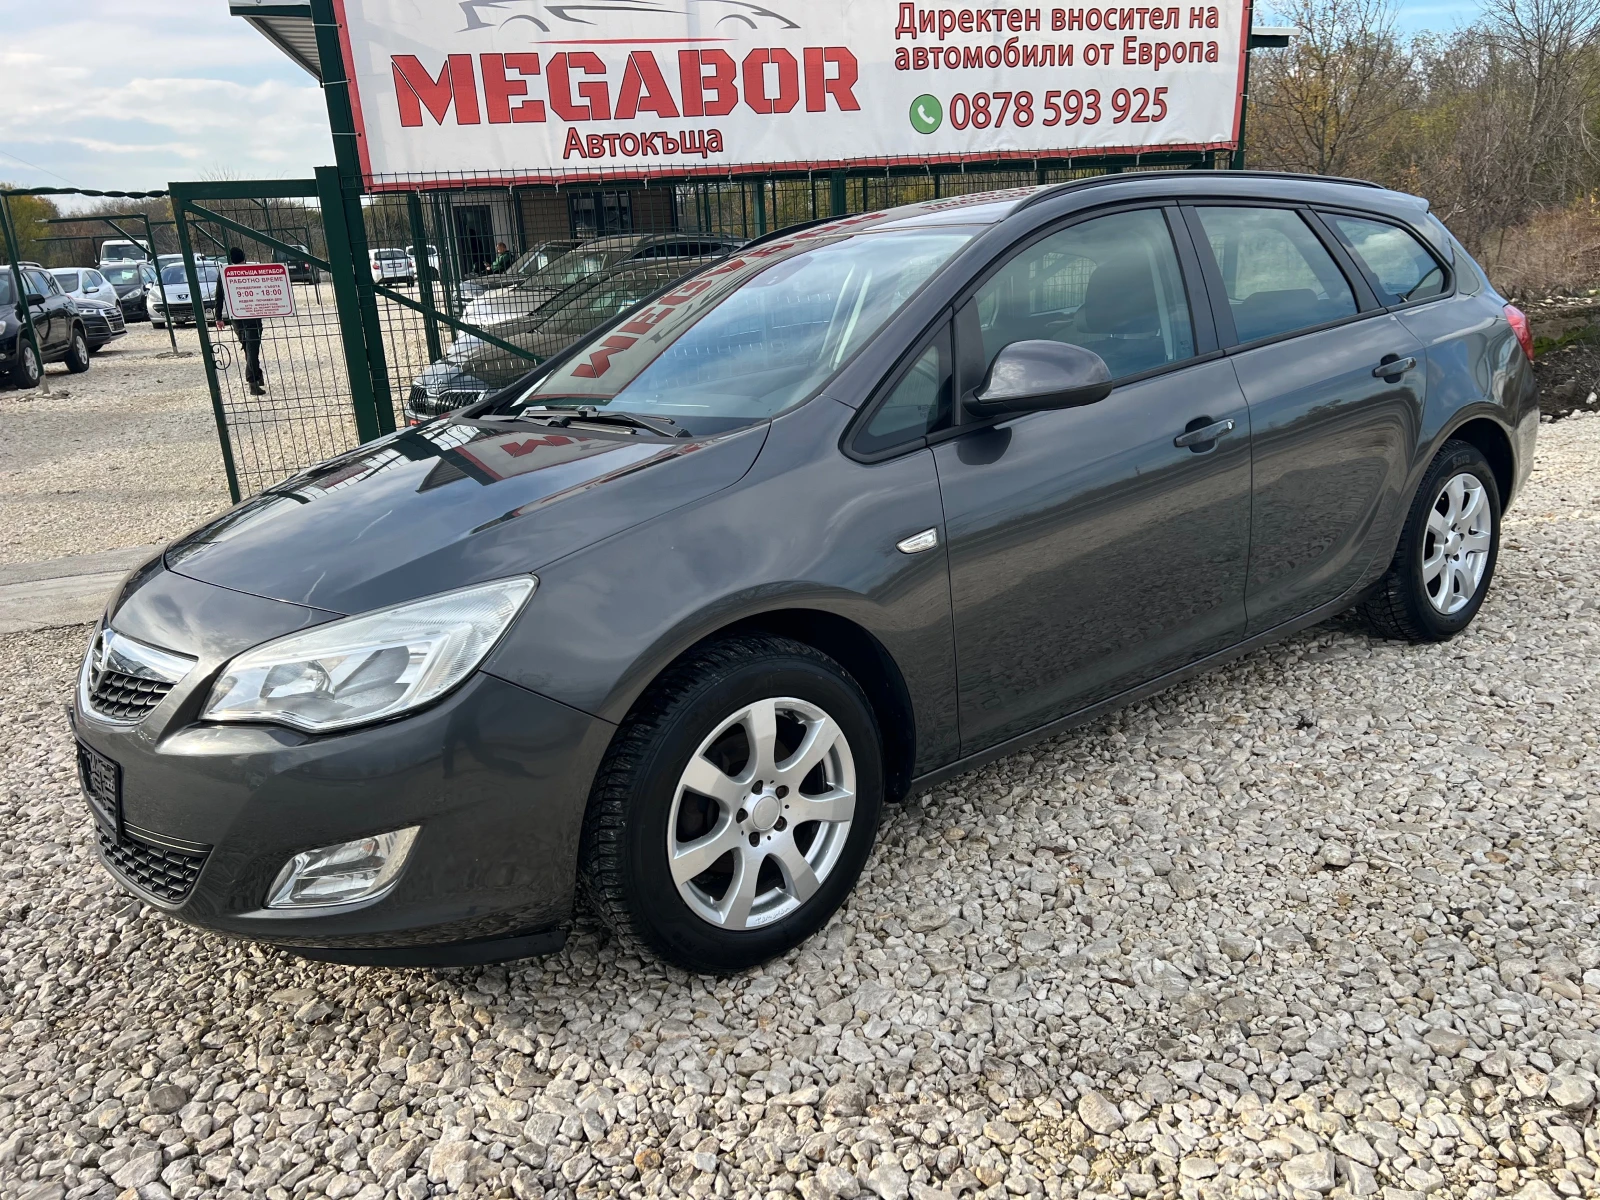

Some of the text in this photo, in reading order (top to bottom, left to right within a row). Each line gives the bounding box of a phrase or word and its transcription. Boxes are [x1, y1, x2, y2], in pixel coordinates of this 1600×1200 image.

[895, 3, 1218, 40] Директен вносител на
[895, 36, 1218, 71] автомобили от Европа
[391, 47, 861, 127] MEGABOR
[949, 86, 1168, 130] 0878 593 925
[563, 127, 723, 159] Автокъща
